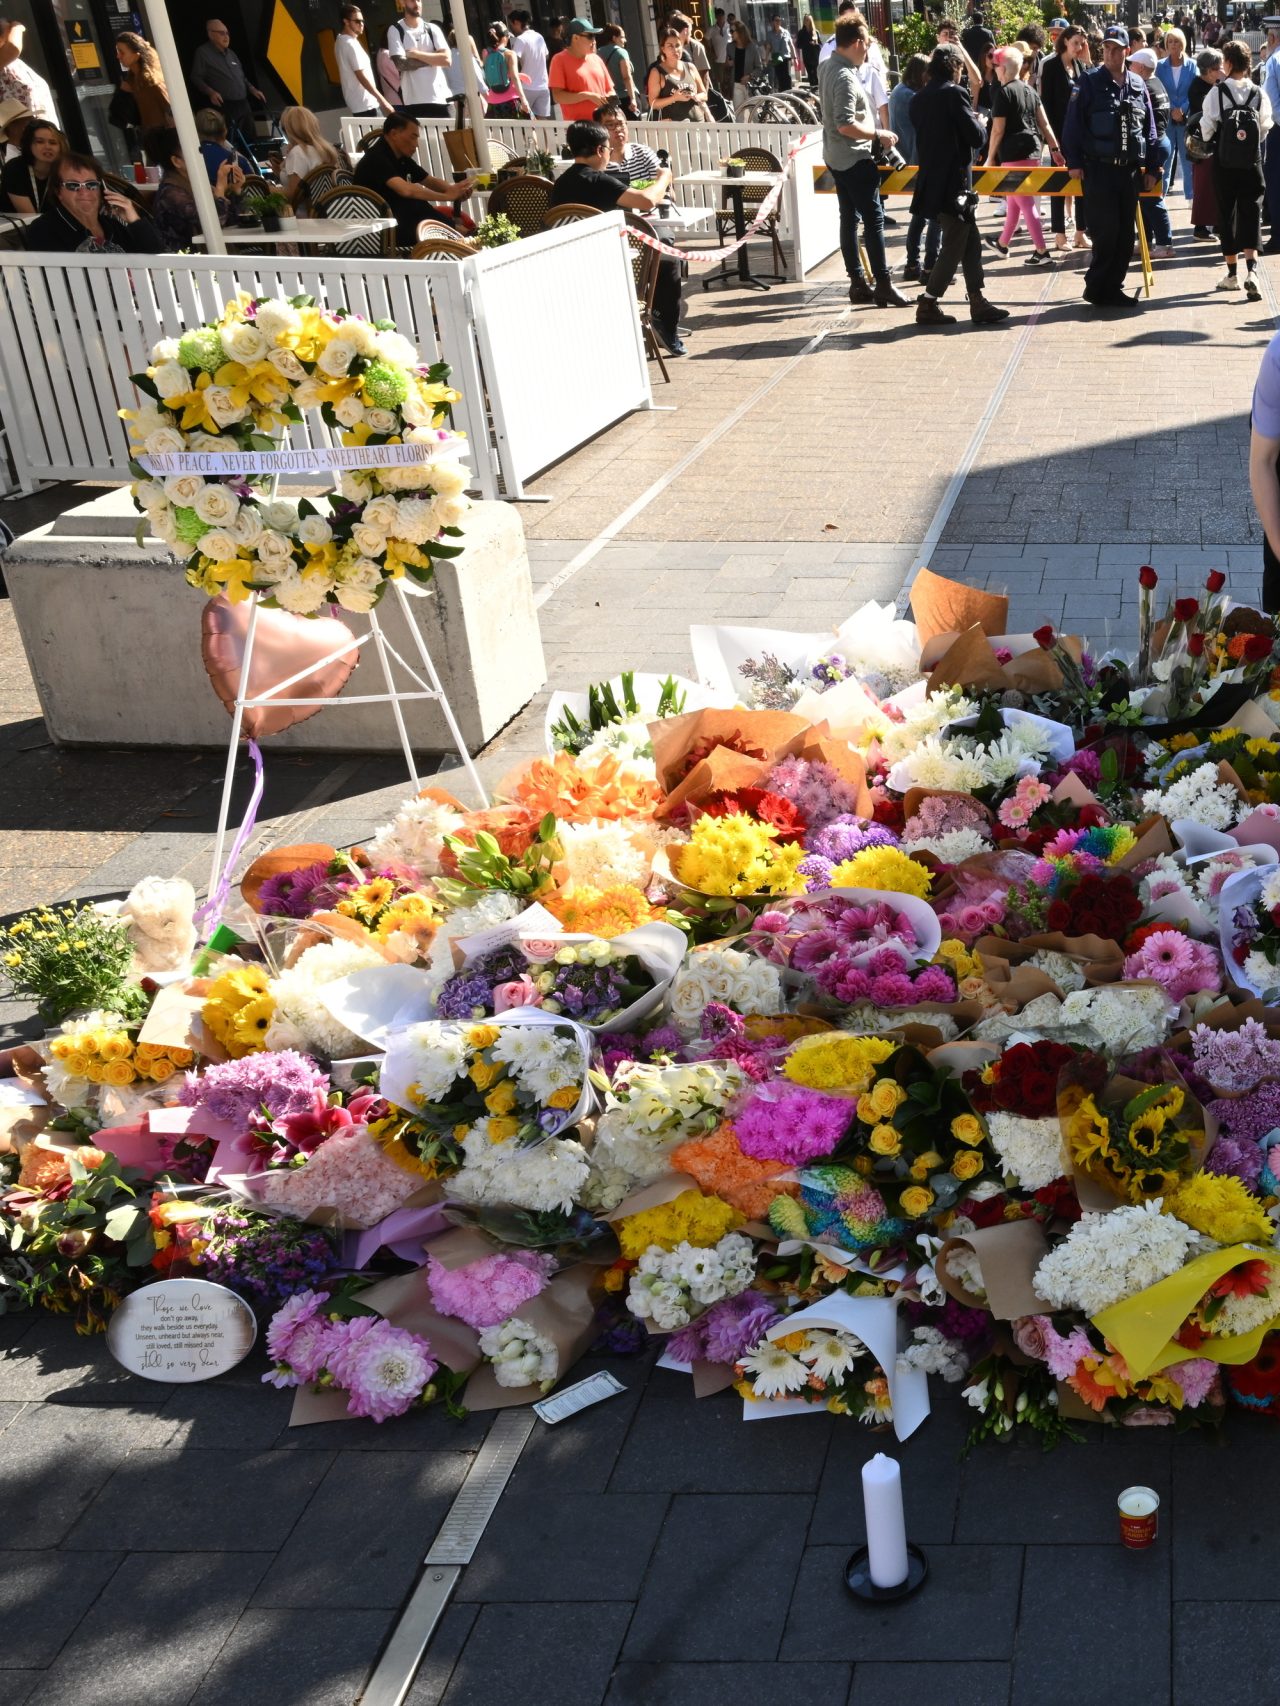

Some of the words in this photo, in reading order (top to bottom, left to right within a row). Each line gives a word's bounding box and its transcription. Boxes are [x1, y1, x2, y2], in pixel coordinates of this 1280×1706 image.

[1120, 115, 1128, 151] RANGER
[221, 453, 256, 471] NEVER
[260, 451, 319, 471] FORGOTTEN
[326, 446, 392, 467] SWEETHEART
[147, 1293, 175, 1316] Those
[192, 1293, 213, 1312] love
[135, 1333, 157, 1341] Unseen,
[158, 1332, 181, 1340] unheard
[192, 1332, 210, 1340] always
[141, 1324, 152, 1332] they
[156, 1342, 173, 1350] loved,
[184, 1341, 203, 1349] missed
[136, 1350, 163, 1370] still
[166, 1361, 175, 1370] so
[179, 1360, 197, 1373] very
[198, 1348, 219, 1367] dear
